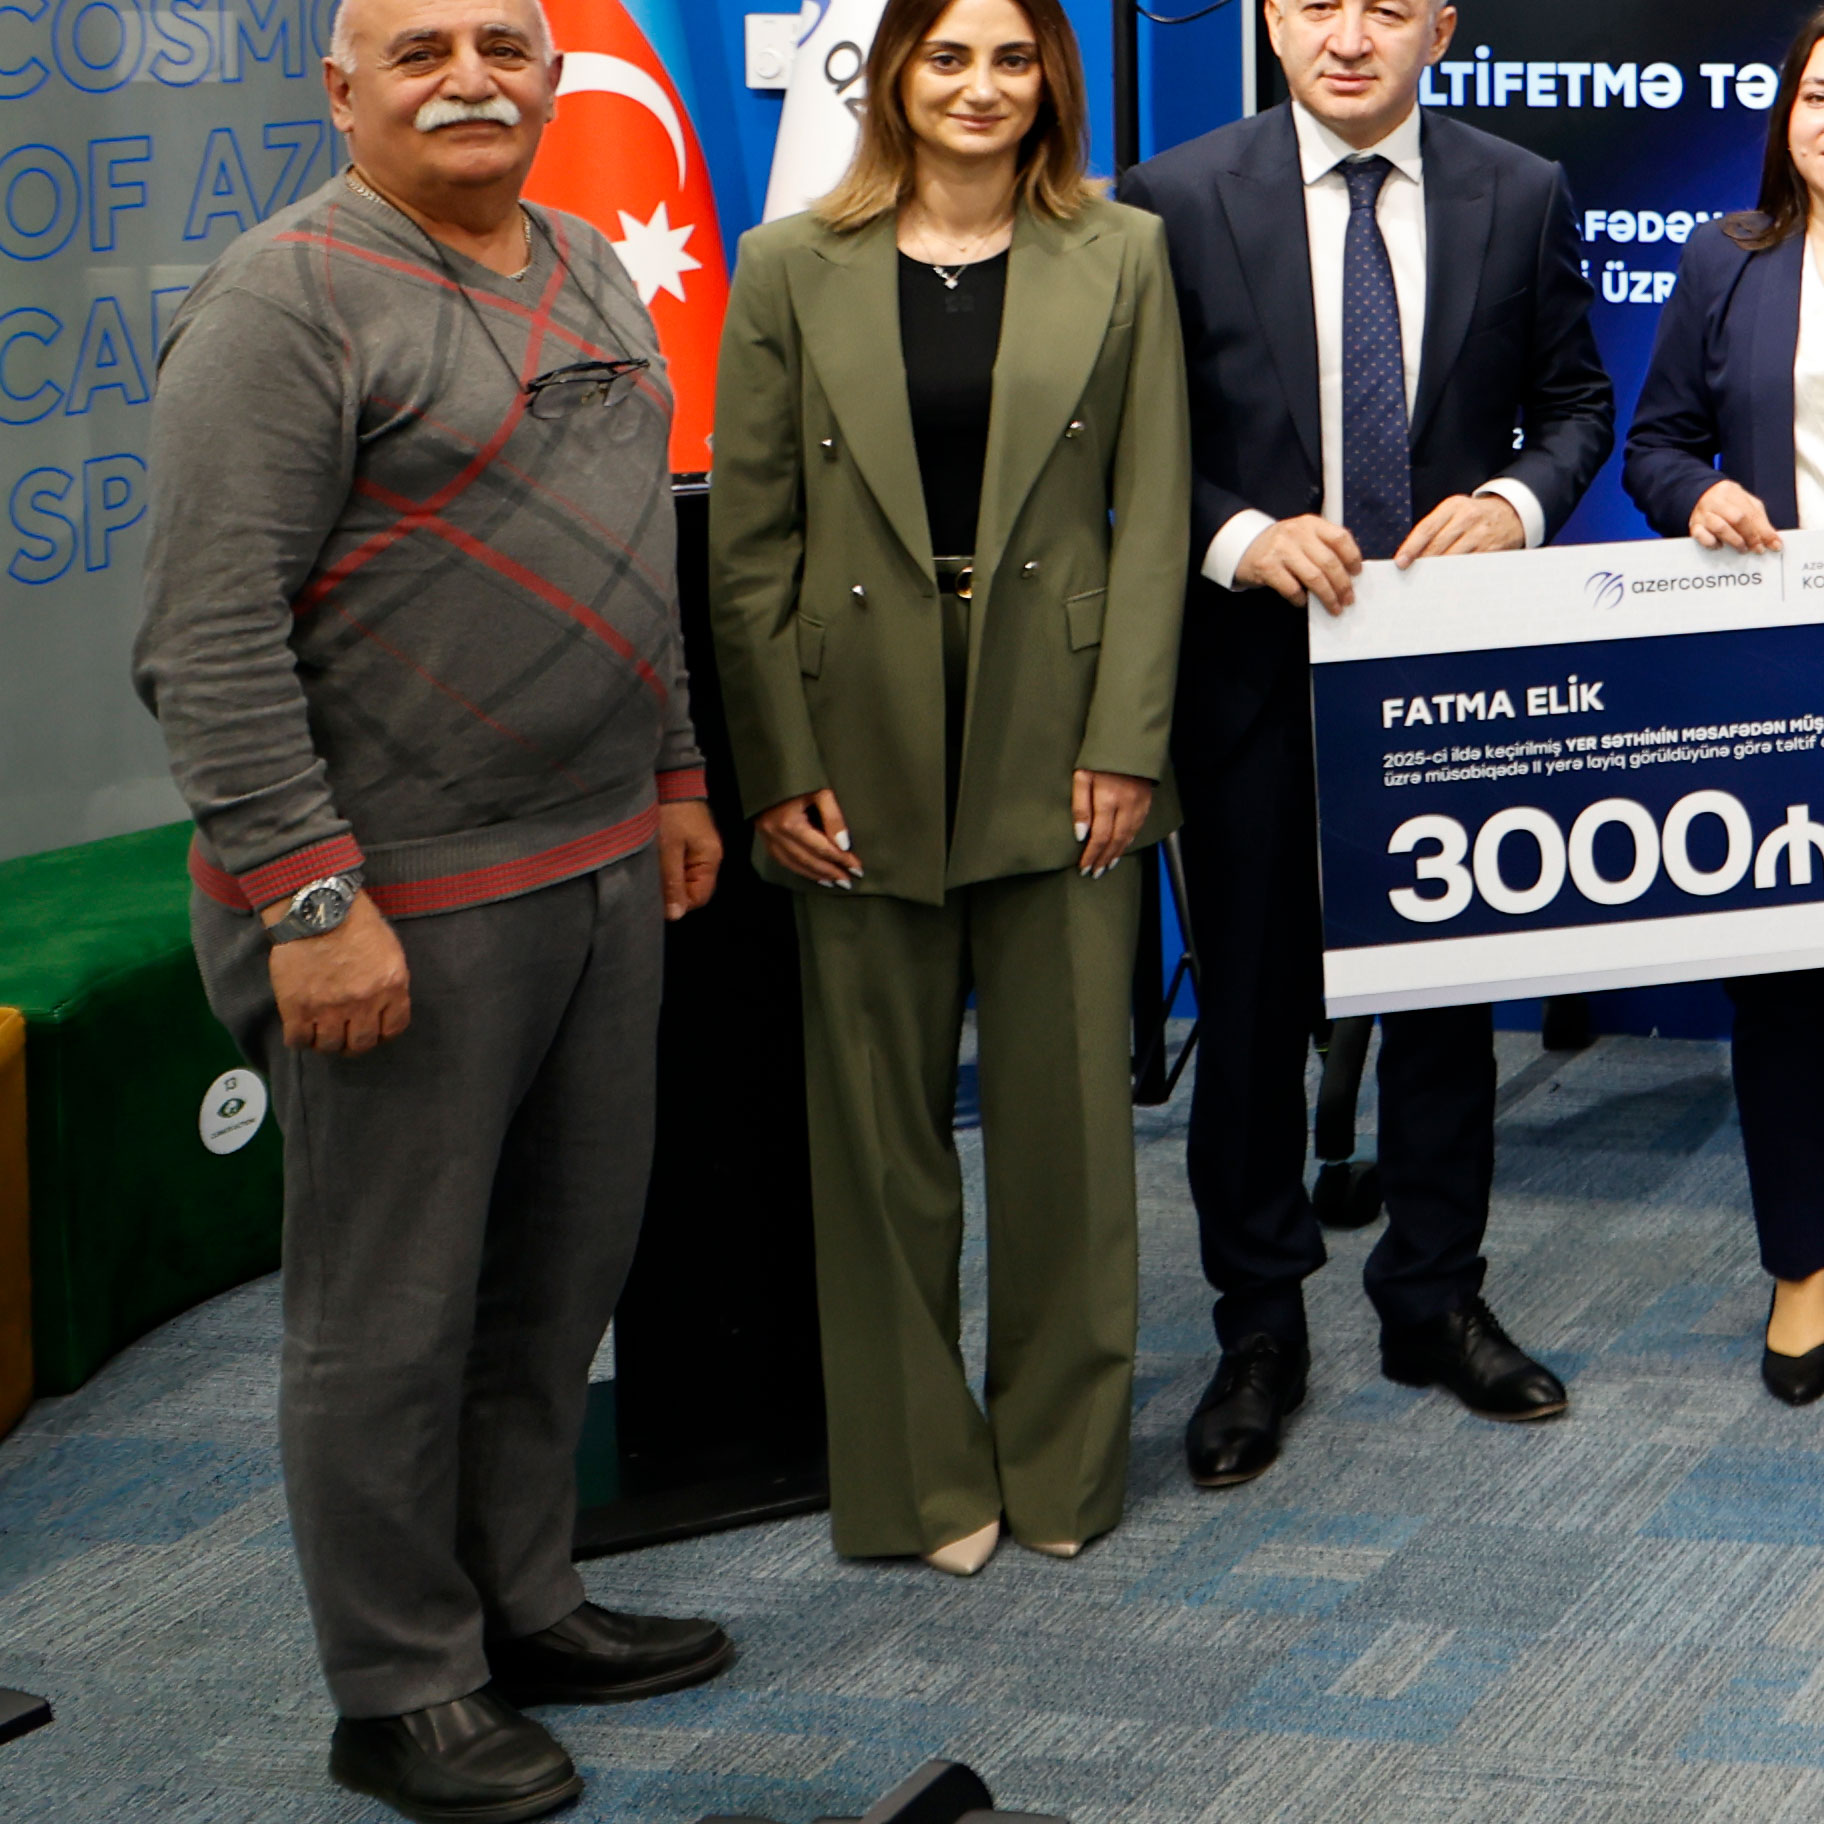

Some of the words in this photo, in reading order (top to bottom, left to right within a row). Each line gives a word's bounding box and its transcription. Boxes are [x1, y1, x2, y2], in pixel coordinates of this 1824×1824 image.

[1418, 45, 1683, 110] LTİFETMƏ
[0, 135, 152, 262] OF
[1602, 260, 1678, 304] ÜZR
[8, 453, 149, 585] SP
[1631, 570, 1762, 594] azercosmos
[1382, 689, 1516, 729] FATMA
[1526, 674, 1605, 717] ELİK
[1383, 745, 1449, 769] 2025-ci
[1451, 745, 1482, 763] ildə
[1485, 738, 1562, 760] keçirilmiş
[1565, 735, 1598, 753] YER
[1601, 725, 1678, 749] SƏTHİNİN
[1383, 770, 1422, 787] üzrə
[1545, 759, 1584, 777] yerə
[1586, 752, 1627, 773] layiq
[1733, 739, 1773, 761] görə
